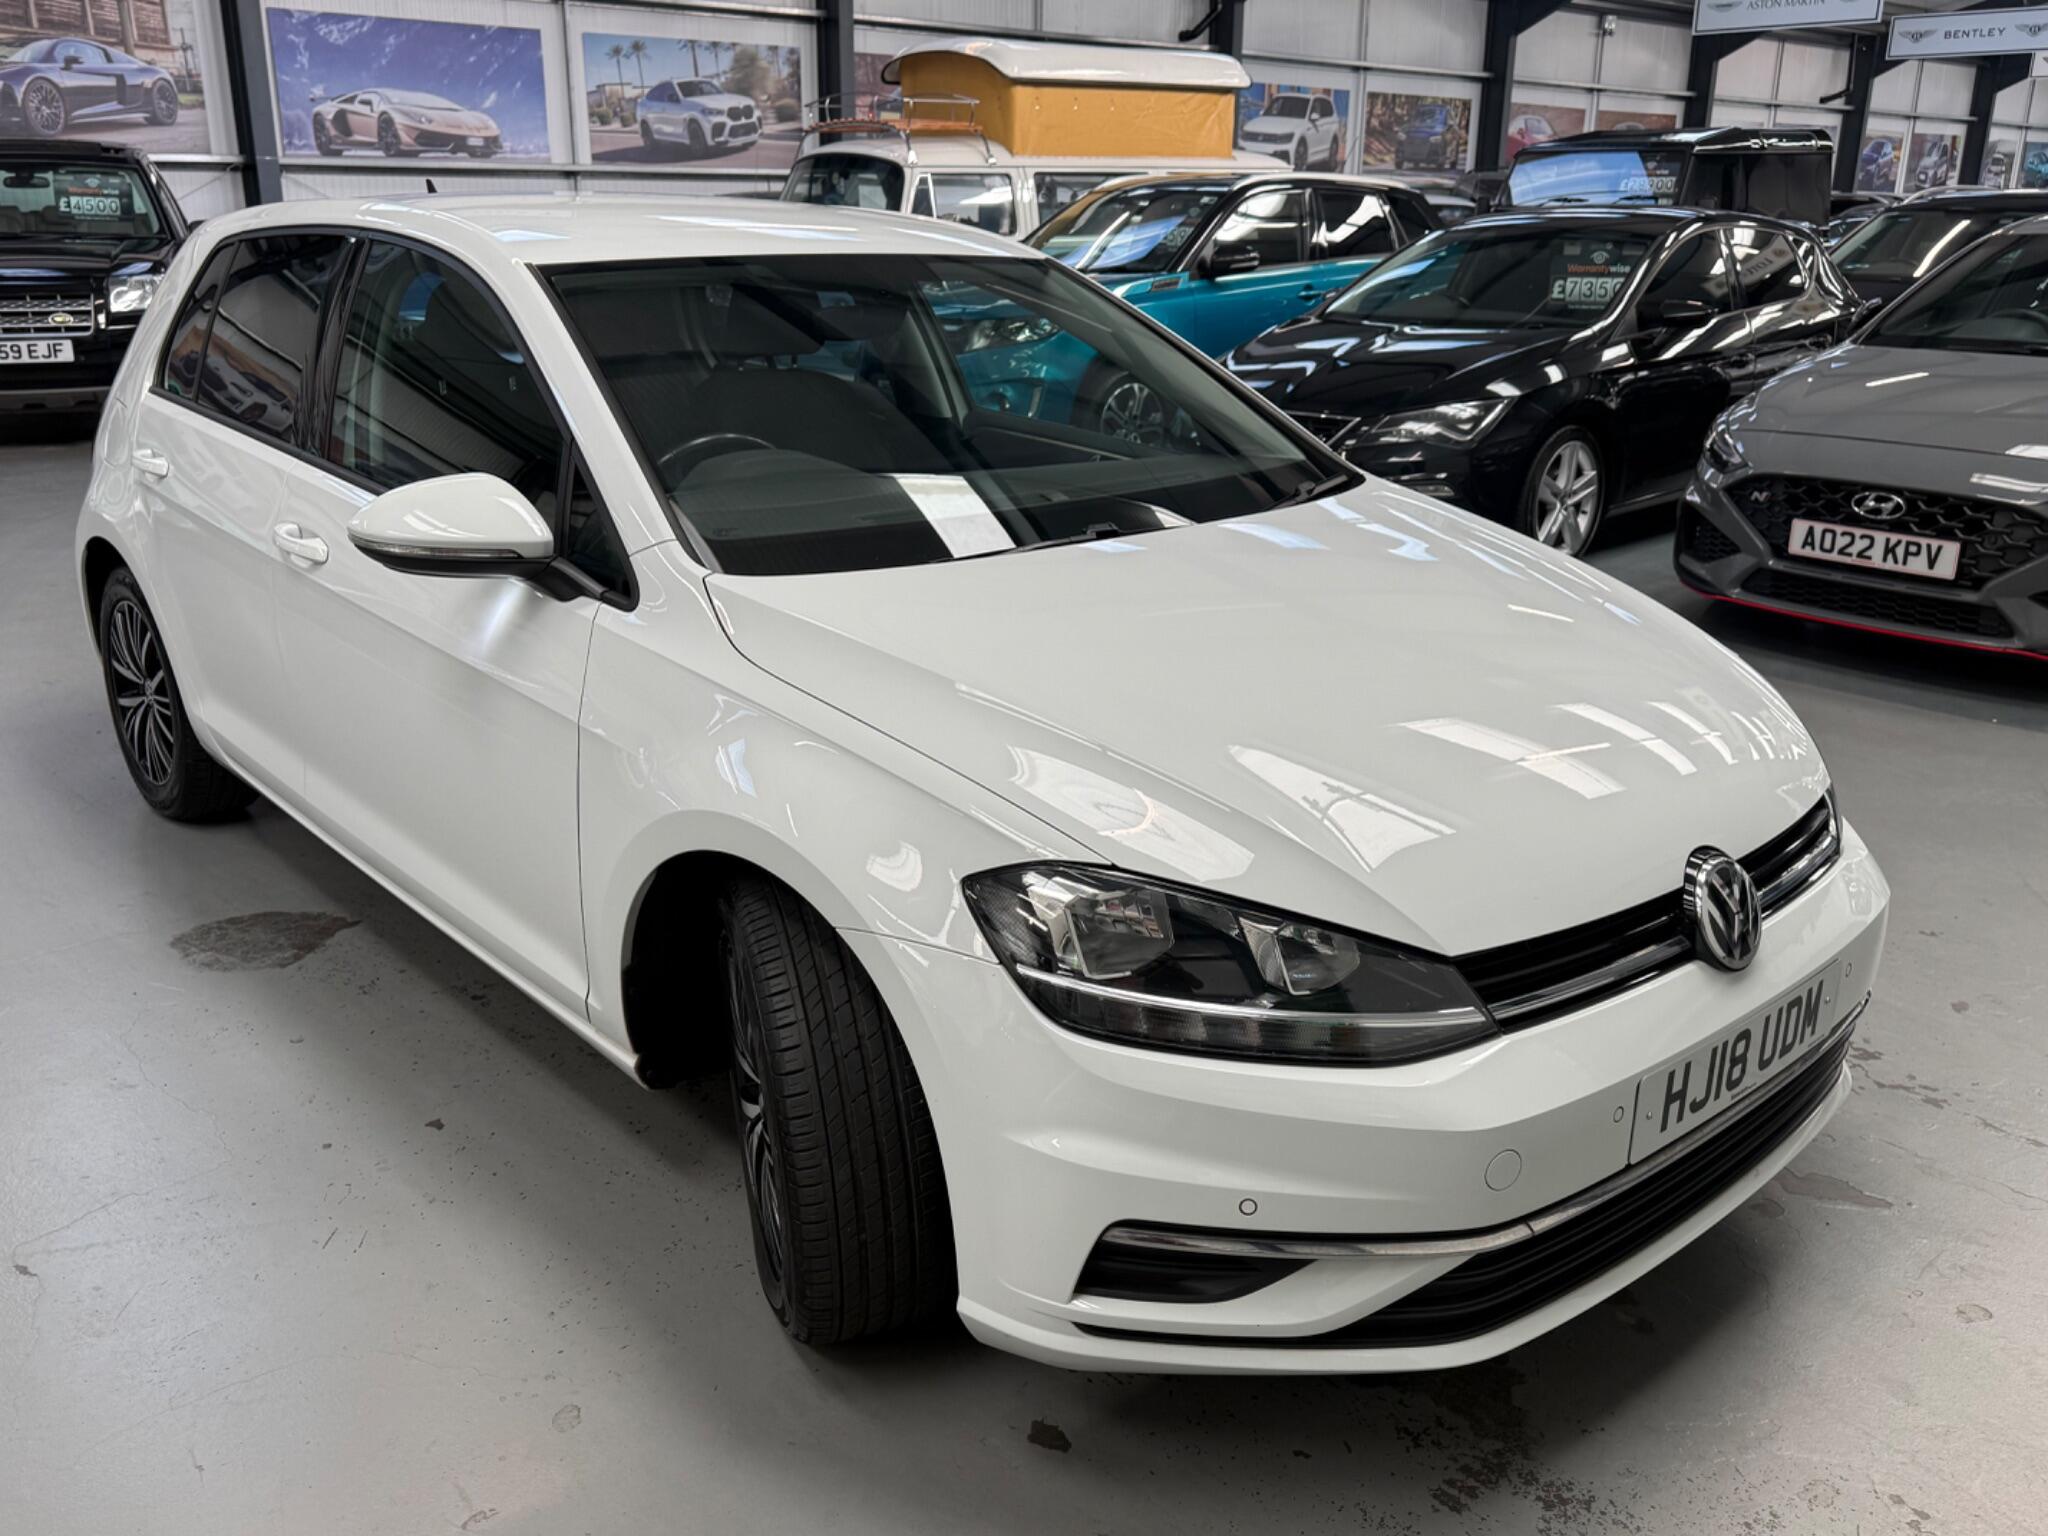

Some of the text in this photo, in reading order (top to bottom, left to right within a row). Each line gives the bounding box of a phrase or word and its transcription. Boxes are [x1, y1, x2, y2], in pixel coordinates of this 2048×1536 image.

[1944, 27, 2006, 40] BENTLEY
[59, 197, 119, 213] £4500
[27, 342, 64, 359] EJF
[1801, 526, 1944, 570] AO22 KPV
[1660, 980, 1824, 1133] HJ18 UDM
